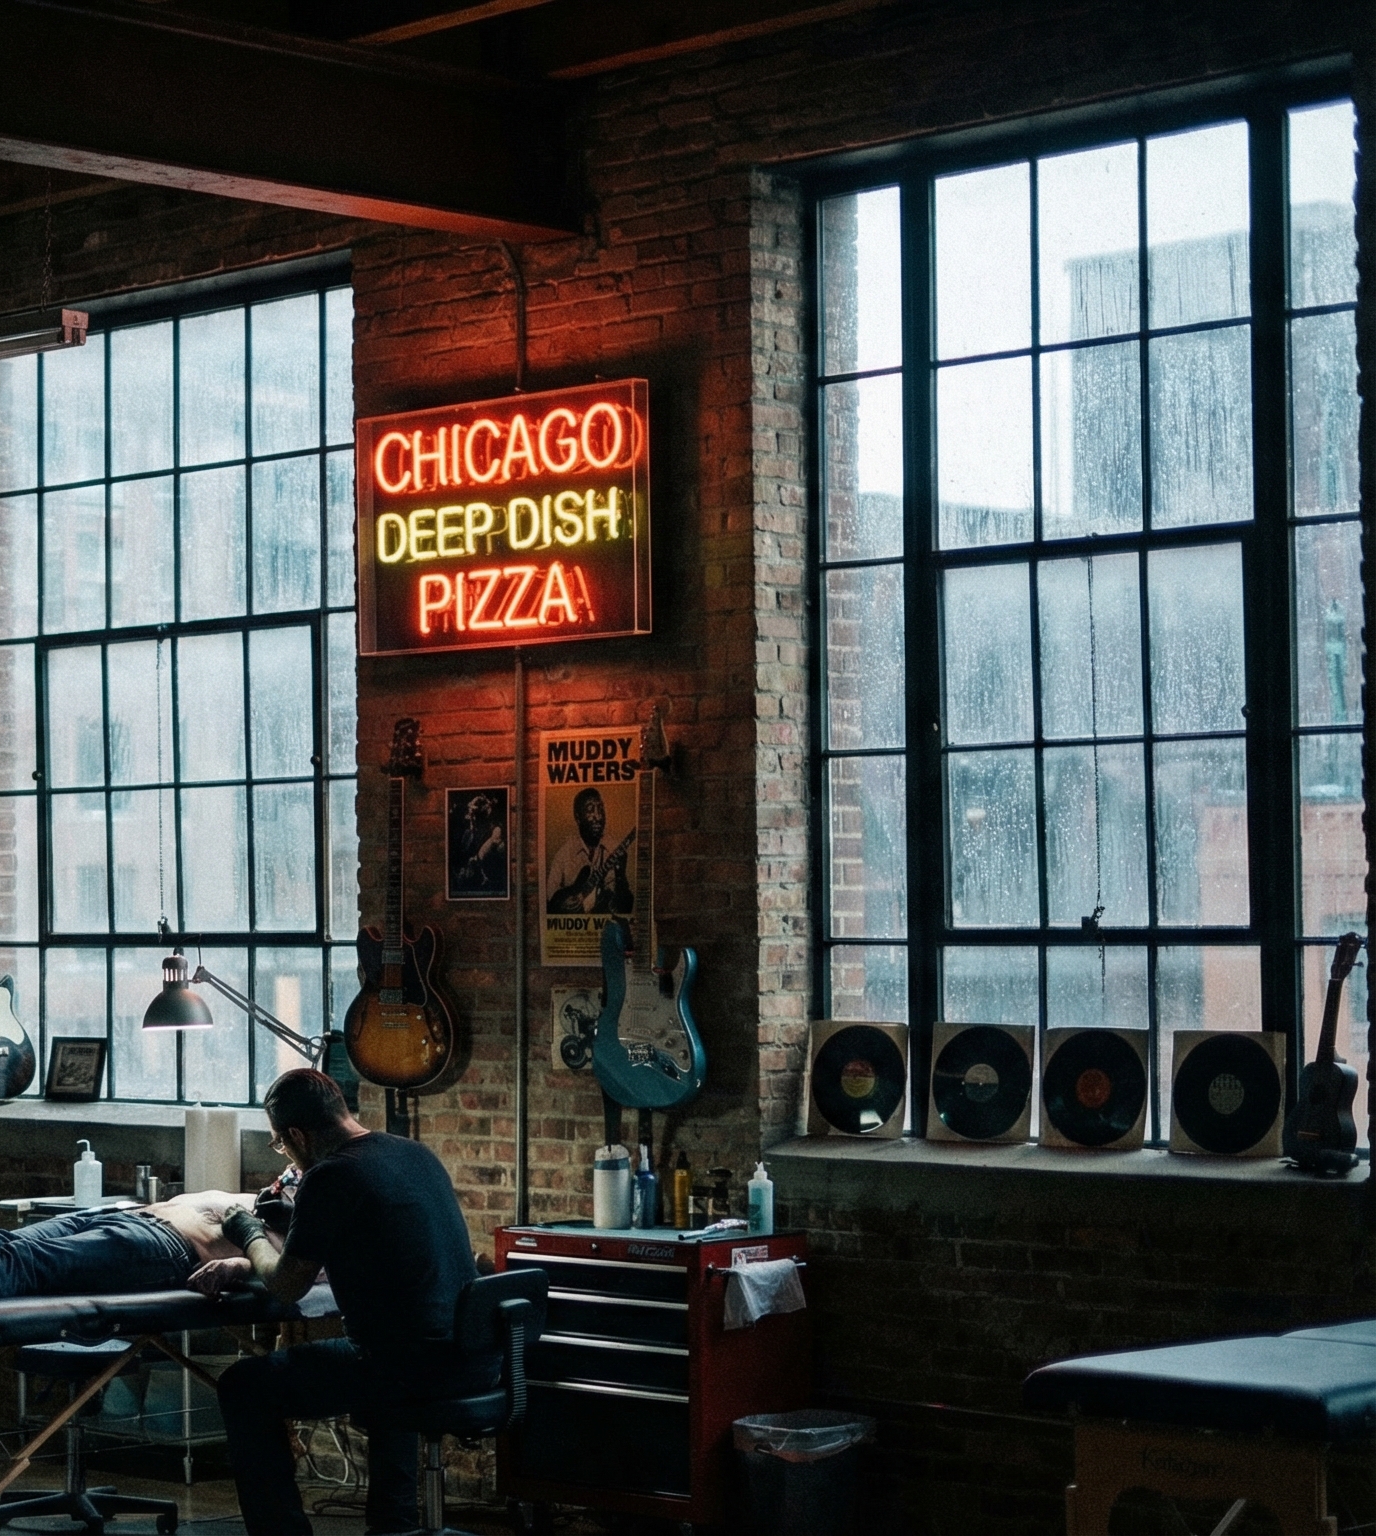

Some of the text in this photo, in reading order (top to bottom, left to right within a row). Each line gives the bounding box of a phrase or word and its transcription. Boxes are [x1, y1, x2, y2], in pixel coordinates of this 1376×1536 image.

[375, 402, 623, 493] CHICAGO
[377, 486, 620, 563] DEEP DISH
[419, 561, 579, 634] PIZZA
[547, 738, 632, 762] MUDDY
[547, 760, 636, 784] WATERS
[546, 917, 591, 931] MUDDY
